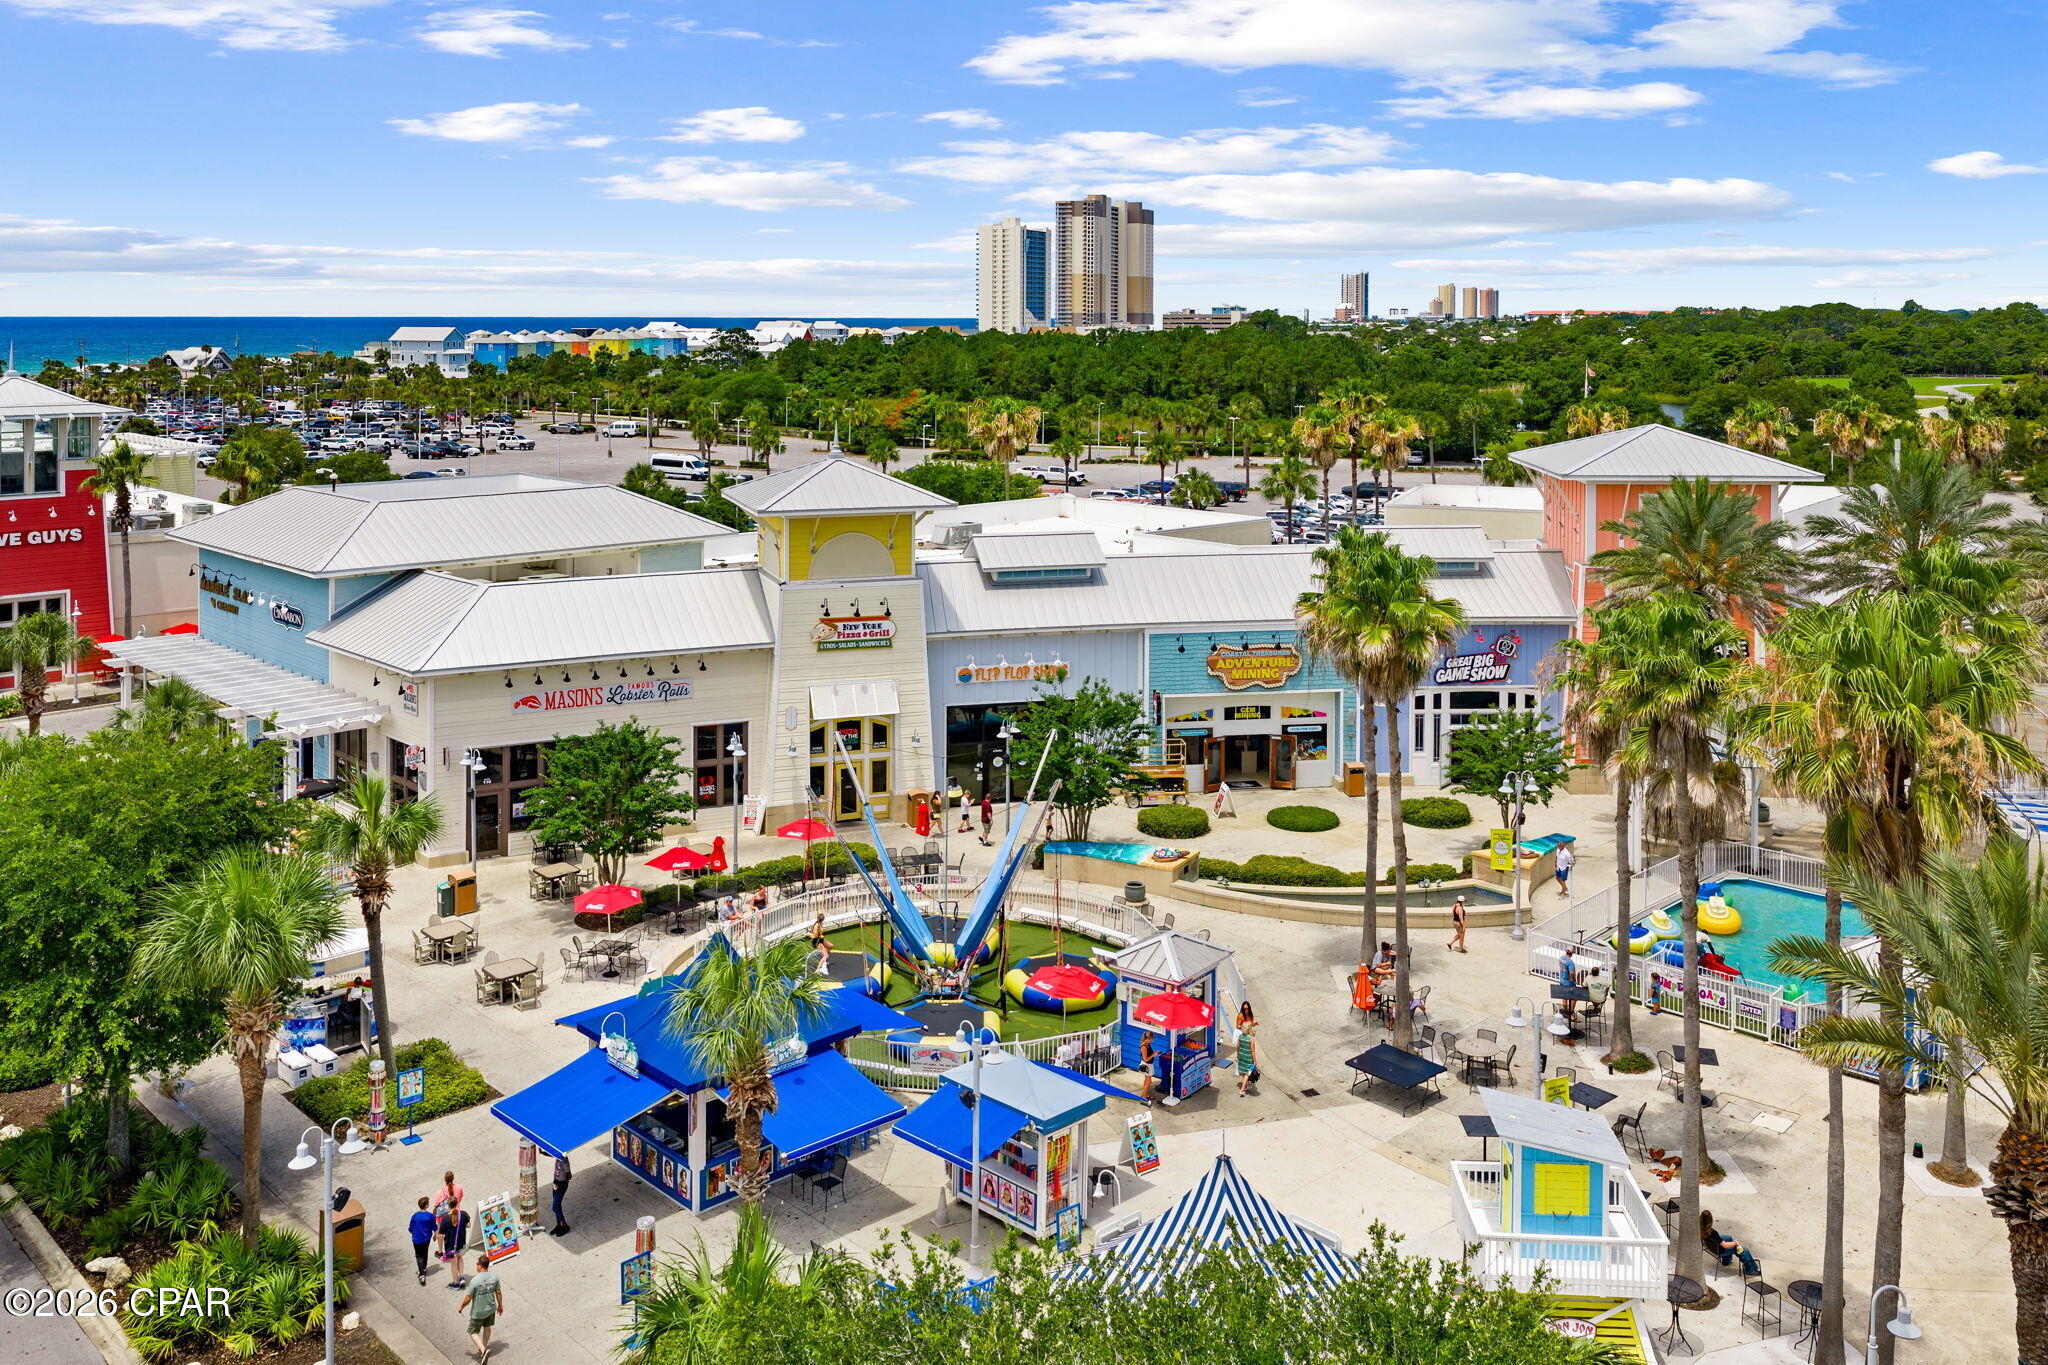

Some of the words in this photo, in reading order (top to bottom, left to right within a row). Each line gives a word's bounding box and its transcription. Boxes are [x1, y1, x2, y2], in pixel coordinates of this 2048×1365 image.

[27, 528, 83, 545] GUYS
[232, 587, 253, 606] SLA
[836, 631, 861, 639] Pizza
[868, 629, 890, 638] Grill
[842, 623, 860, 631] NEW
[861, 622, 883, 630] YORK
[1215, 656, 1295, 669] ADVENTURE
[1446, 655, 1474, 668] GREAT
[1472, 653, 1495, 668] BIG
[974, 666, 1001, 681] FLIP
[1004, 665, 1031, 680] FLOP
[1231, 668, 1280, 680] MINING
[1435, 666, 1471, 683] GAME
[1469, 664, 1509, 682] SHOW
[627, 681, 655, 690] FAMOUS
[544, 686, 603, 711] MASON'S
[606, 685, 656, 705] Lobster
[657, 681, 691, 702] Rolls
[1699, 989, 1726, 1006] OATS
[1740, 1003, 1763, 1016] ENTER
